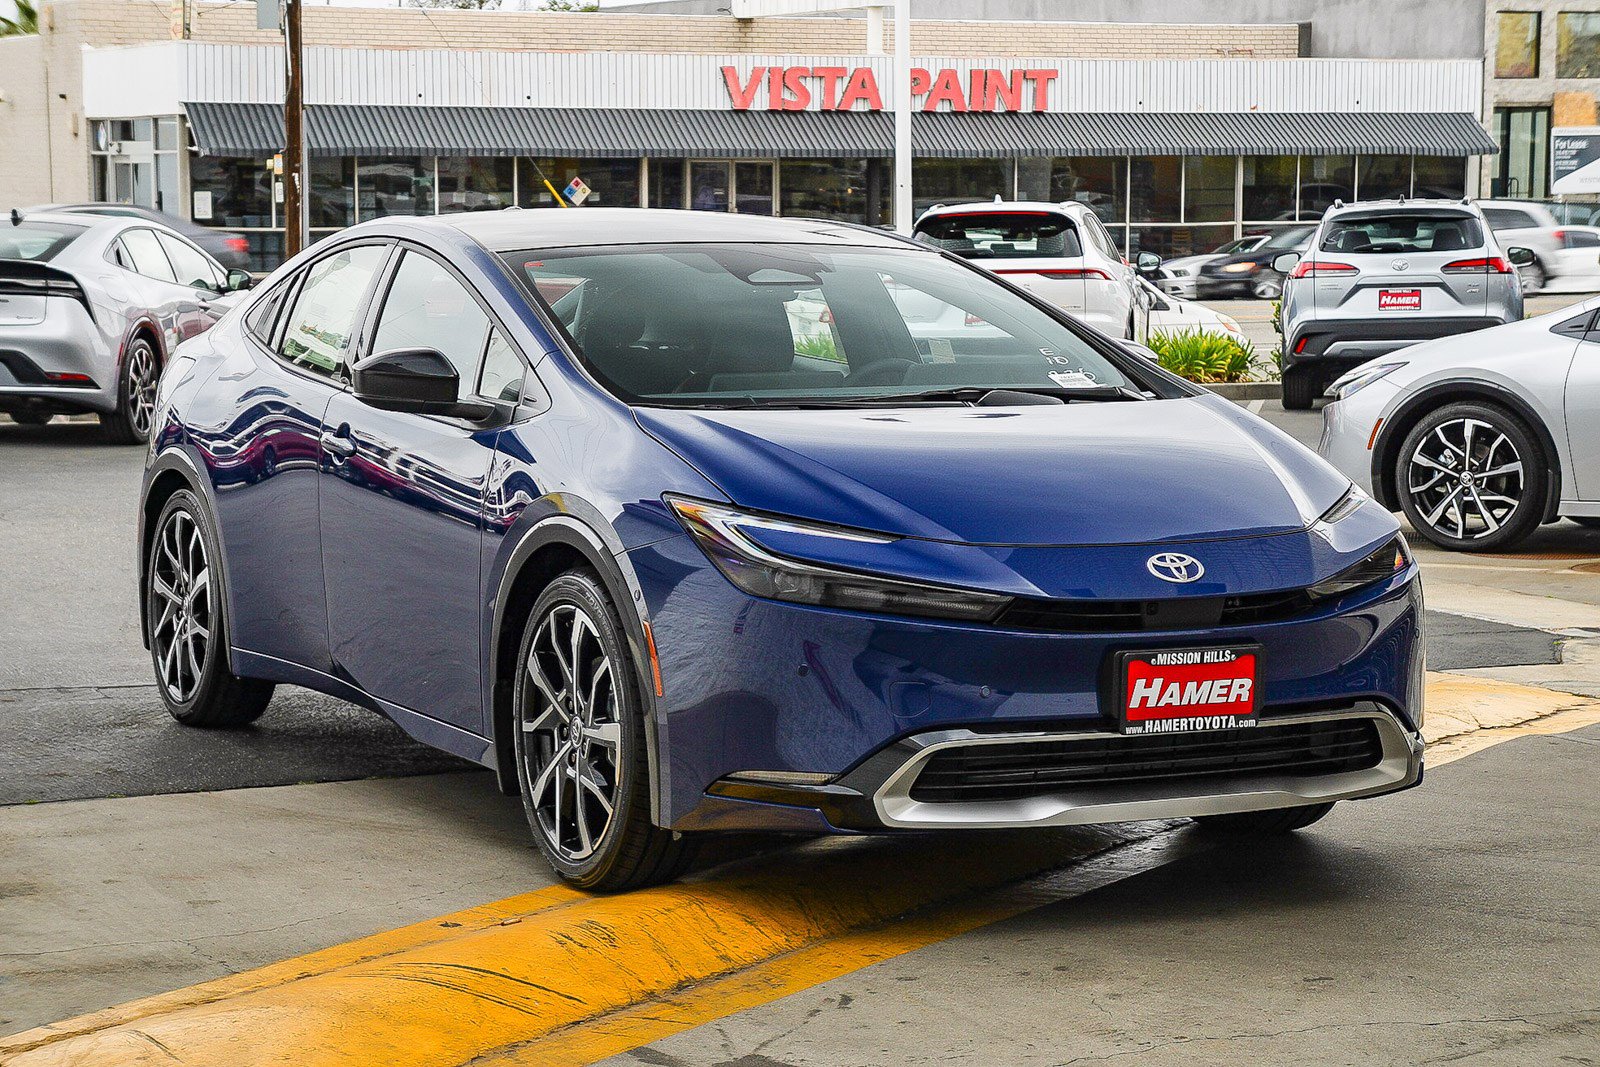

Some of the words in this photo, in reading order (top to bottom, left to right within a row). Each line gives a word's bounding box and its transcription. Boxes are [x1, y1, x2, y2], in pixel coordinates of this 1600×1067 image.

[720, 66, 884, 111] VISTA
[1381, 295, 1420, 305] HAMER
[1157, 652, 1201, 665] MISSION
[1204, 650, 1231, 663] HILLS
[1129, 677, 1253, 708] HAMER
[1126, 715, 1256, 735] www.HAMERTOYOTA.com
